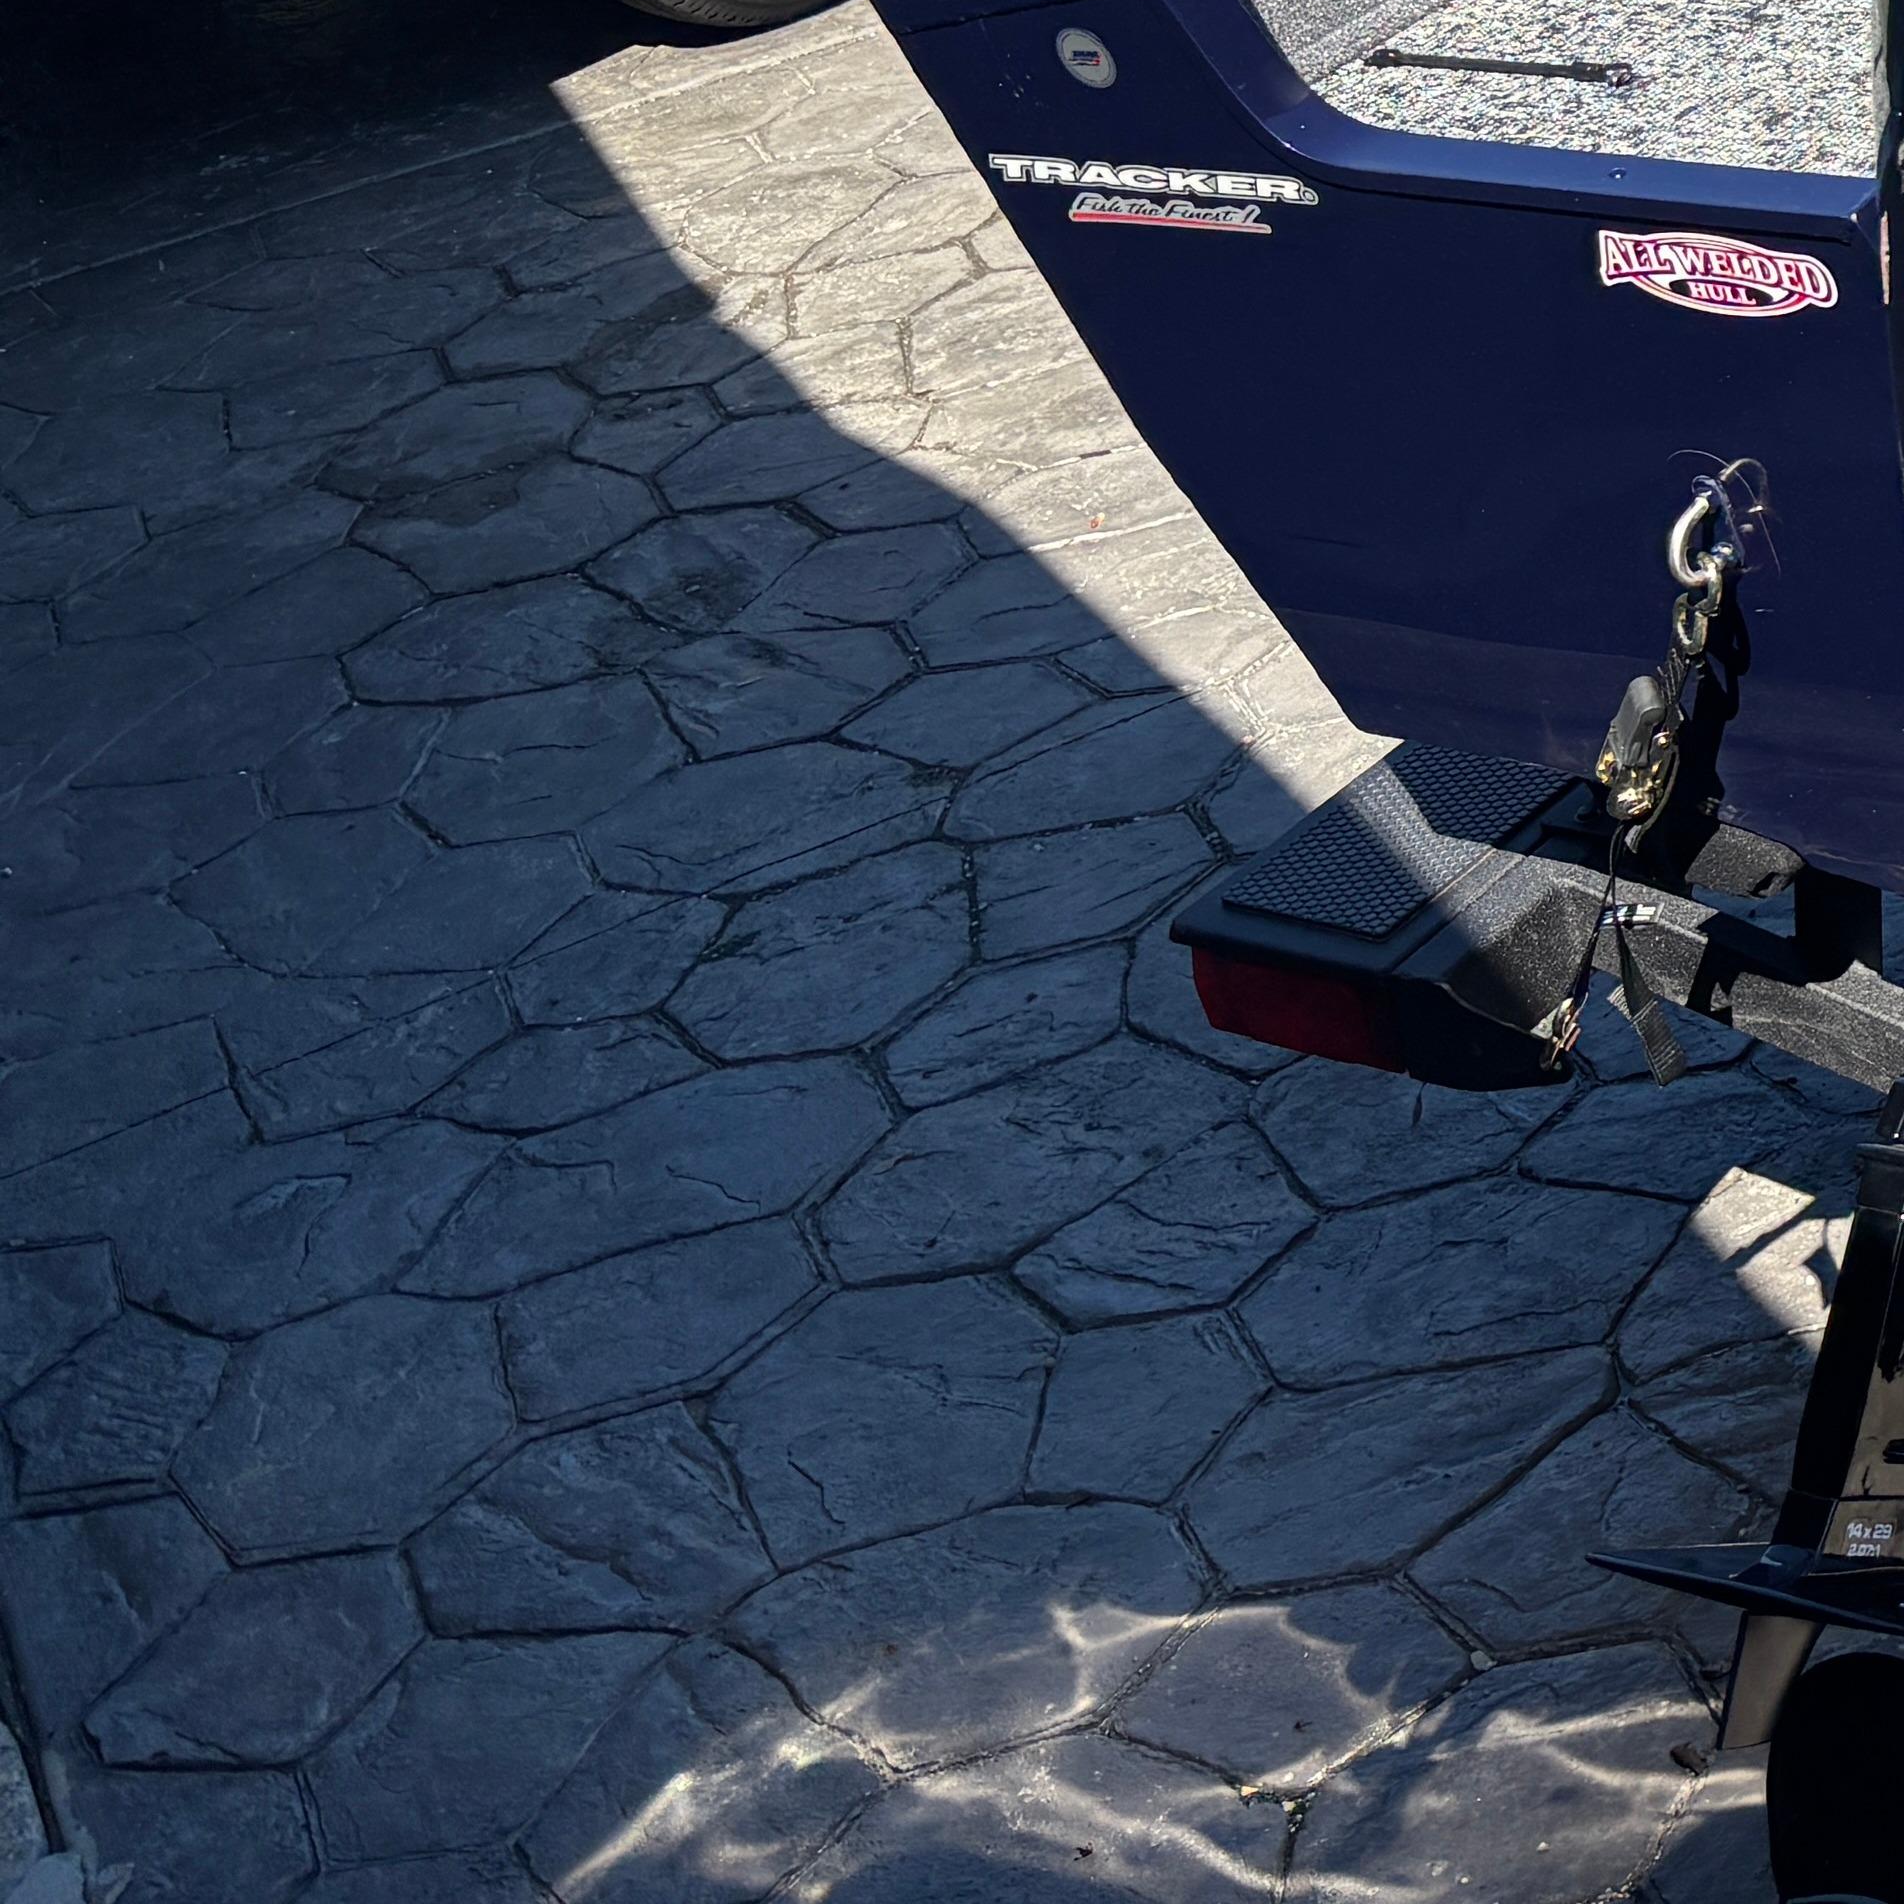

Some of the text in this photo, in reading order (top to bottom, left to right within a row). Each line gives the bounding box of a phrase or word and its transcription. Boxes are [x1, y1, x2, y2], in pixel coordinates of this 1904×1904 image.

[989, 153, 1303, 203] TRACKER
[1605, 235, 1830, 302] ALL WELDED
[1689, 281, 1757, 306] HULL
